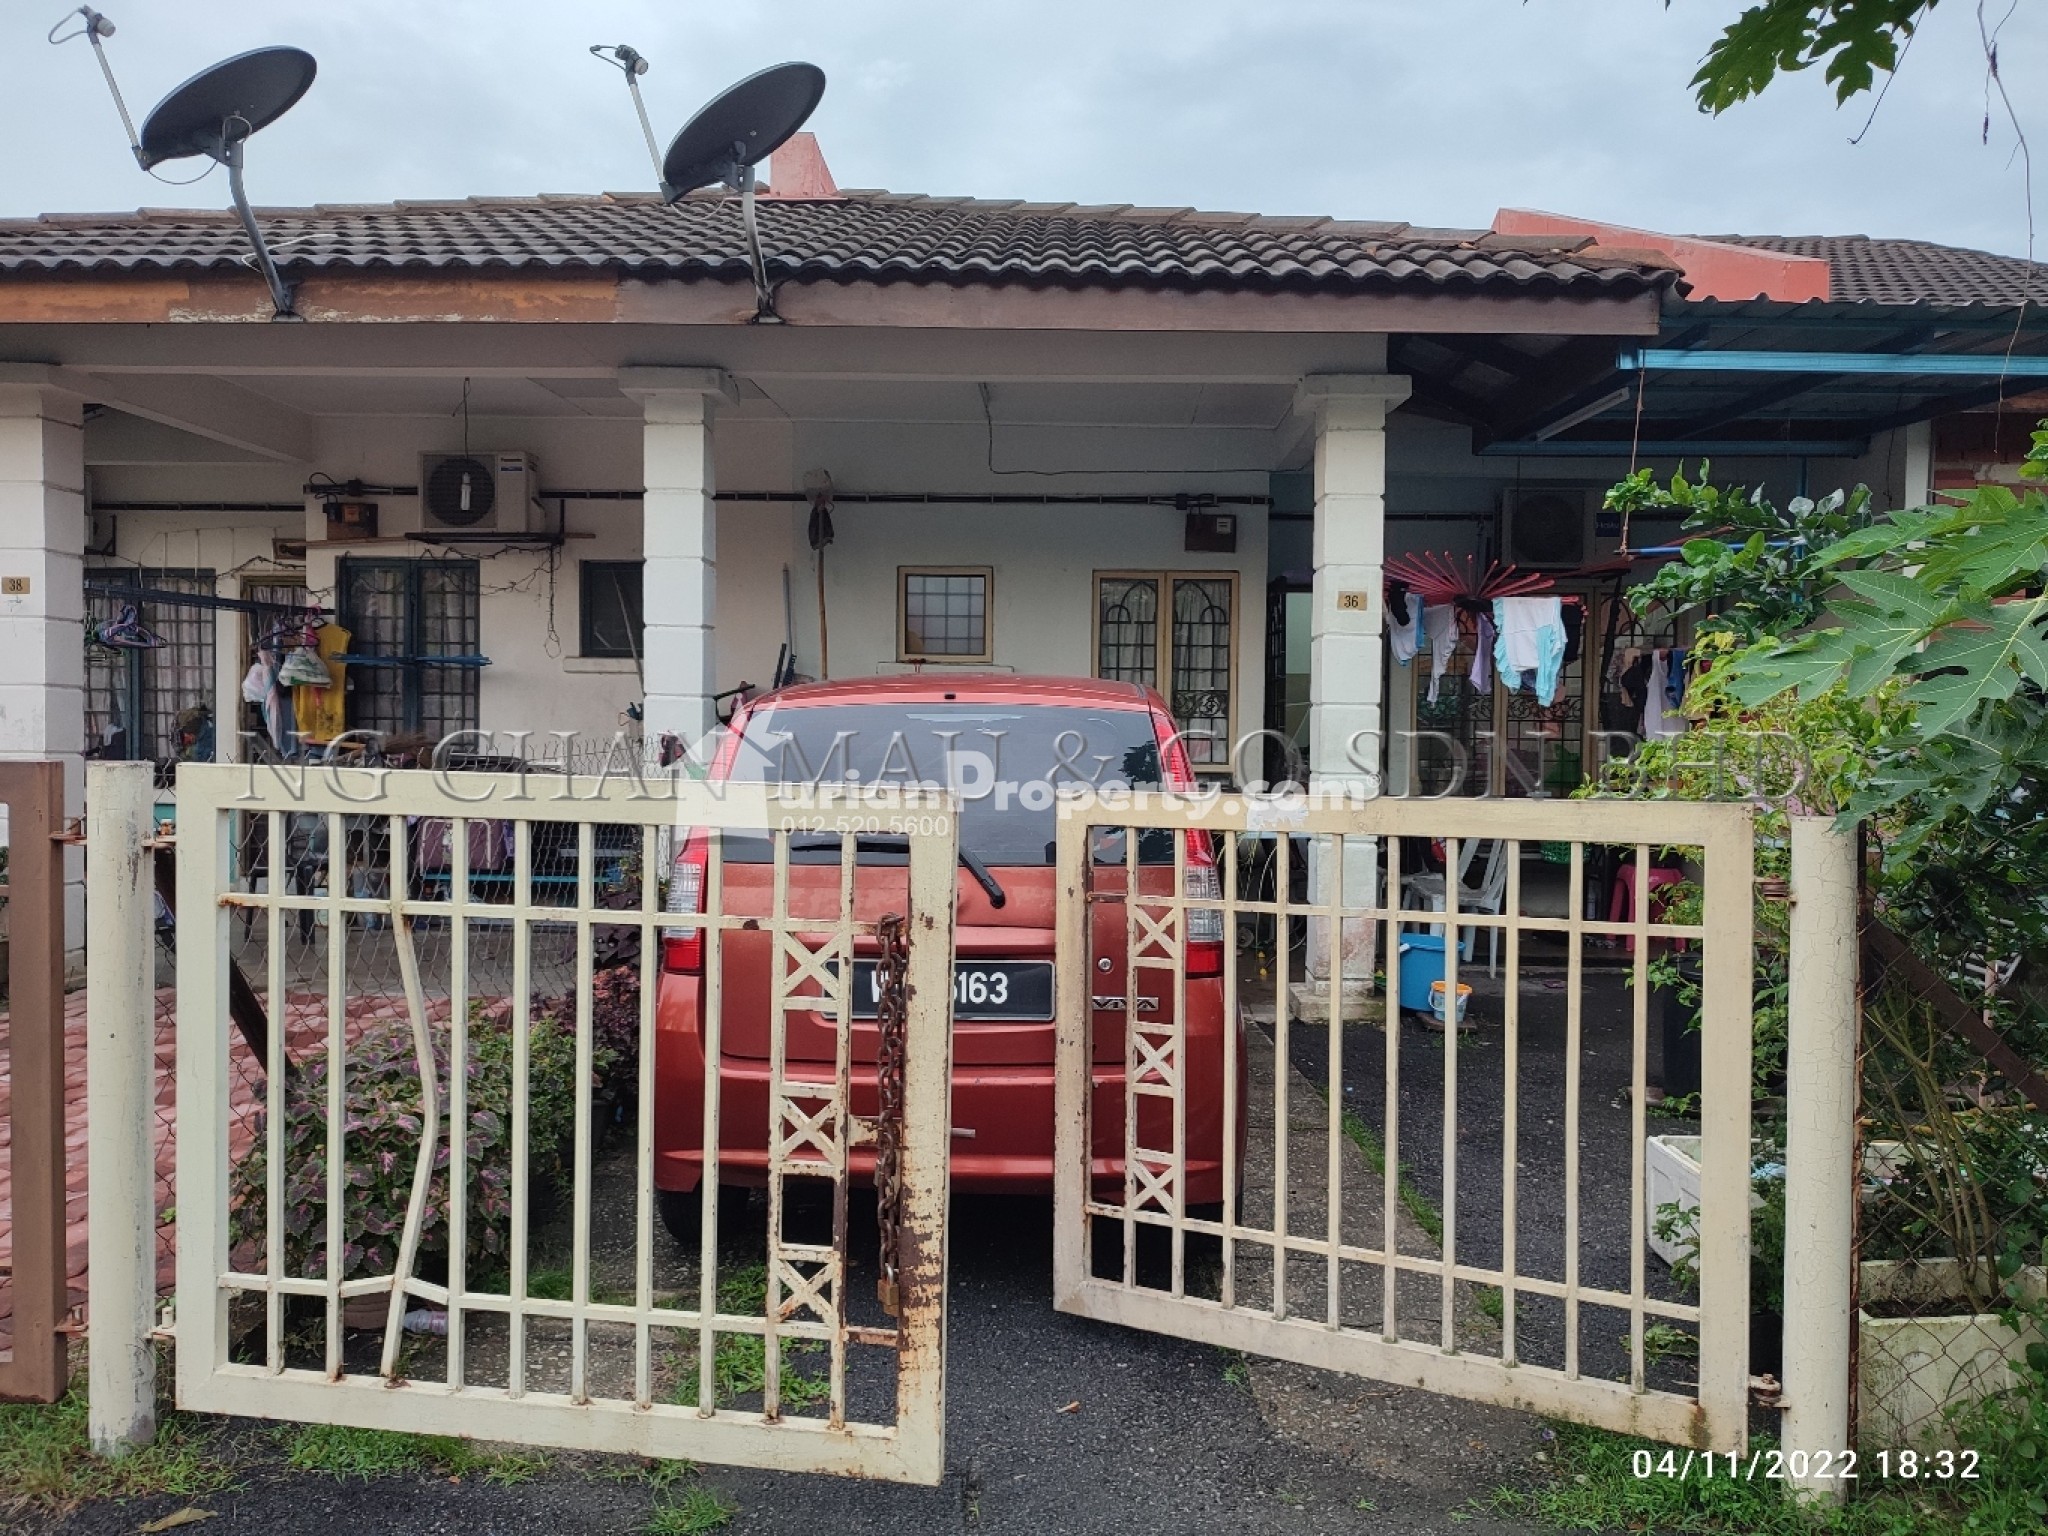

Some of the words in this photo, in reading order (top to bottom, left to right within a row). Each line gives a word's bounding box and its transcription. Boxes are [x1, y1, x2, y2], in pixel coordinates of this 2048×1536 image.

[9, 579, 22, 591] 38
[1343, 595, 1359, 608] 36
[953, 971, 1009, 1004] 163
